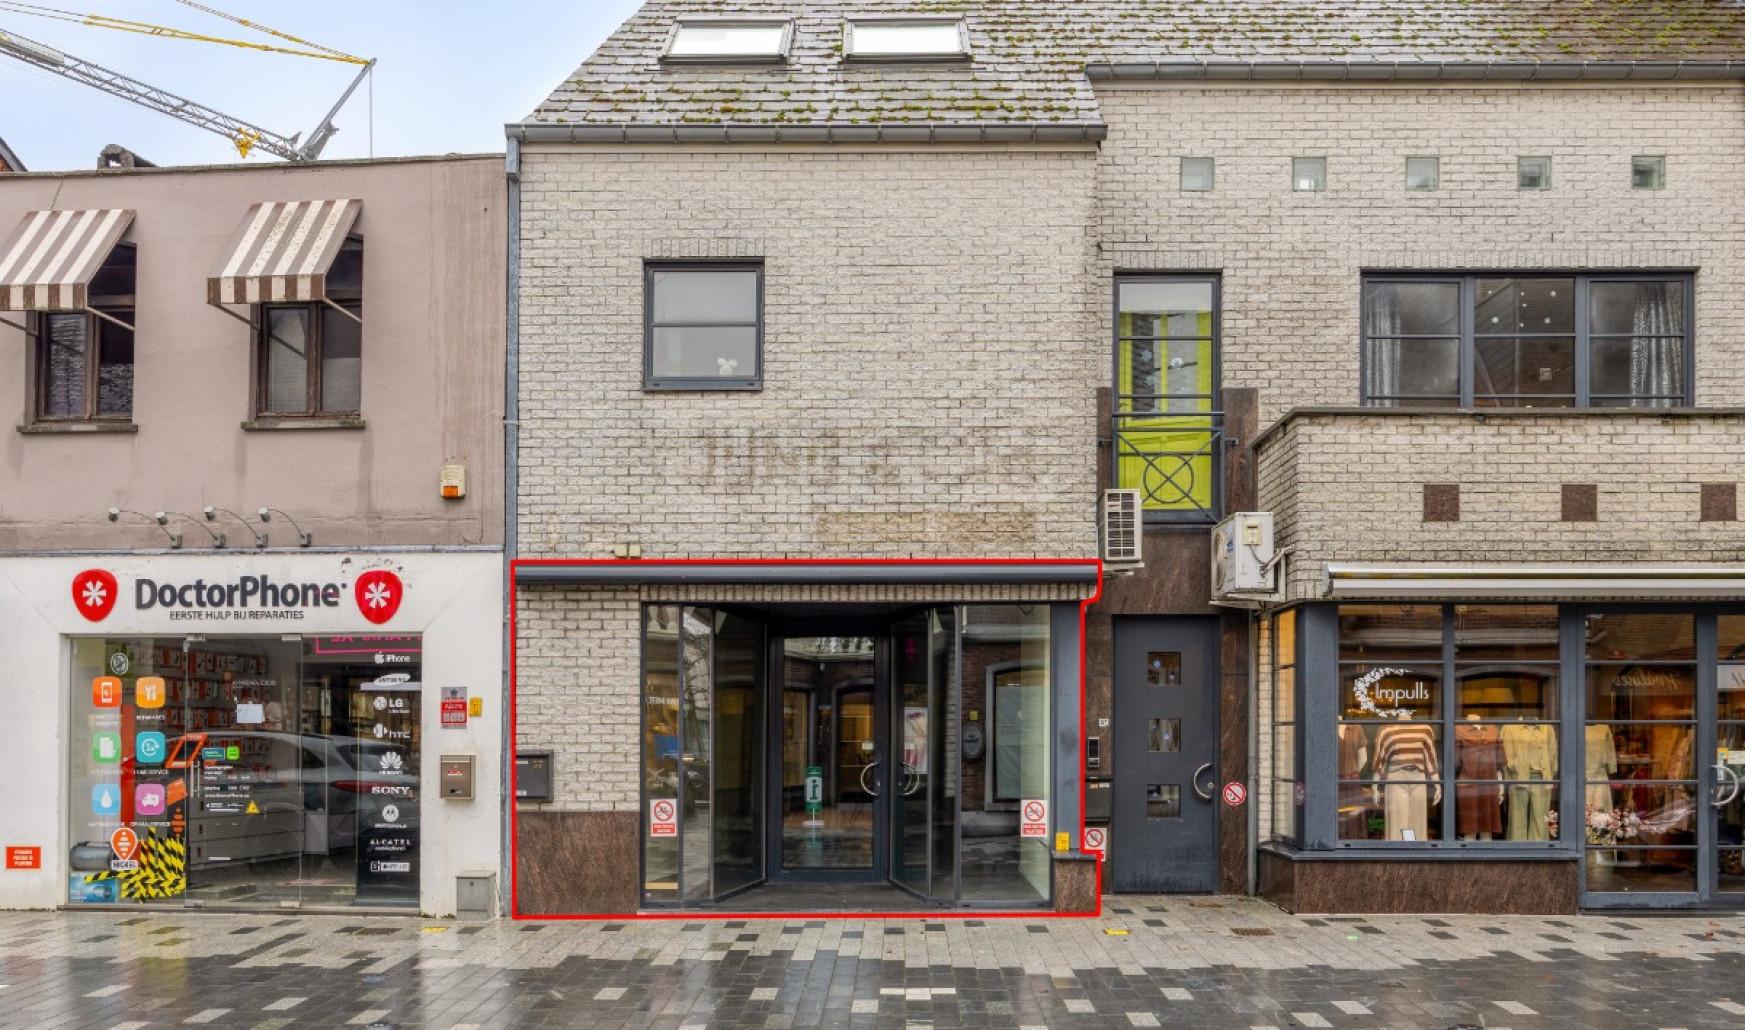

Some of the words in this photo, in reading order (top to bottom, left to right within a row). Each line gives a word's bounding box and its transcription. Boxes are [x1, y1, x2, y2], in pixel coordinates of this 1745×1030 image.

[135, 574, 340, 611] DoctorPhone
[169, 610, 203, 620] EERSTE
[205, 610, 231, 620] HULP
[233, 610, 247, 620] BIJ
[248, 610, 305, 620] REPARATIES
[385, 654, 411, 663] iPhone
[1375, 681, 1429, 708] Impulls
[389, 698, 404, 708] LG
[371, 786, 411, 795] SONY
[369, 838, 412, 846] ALCATEL
